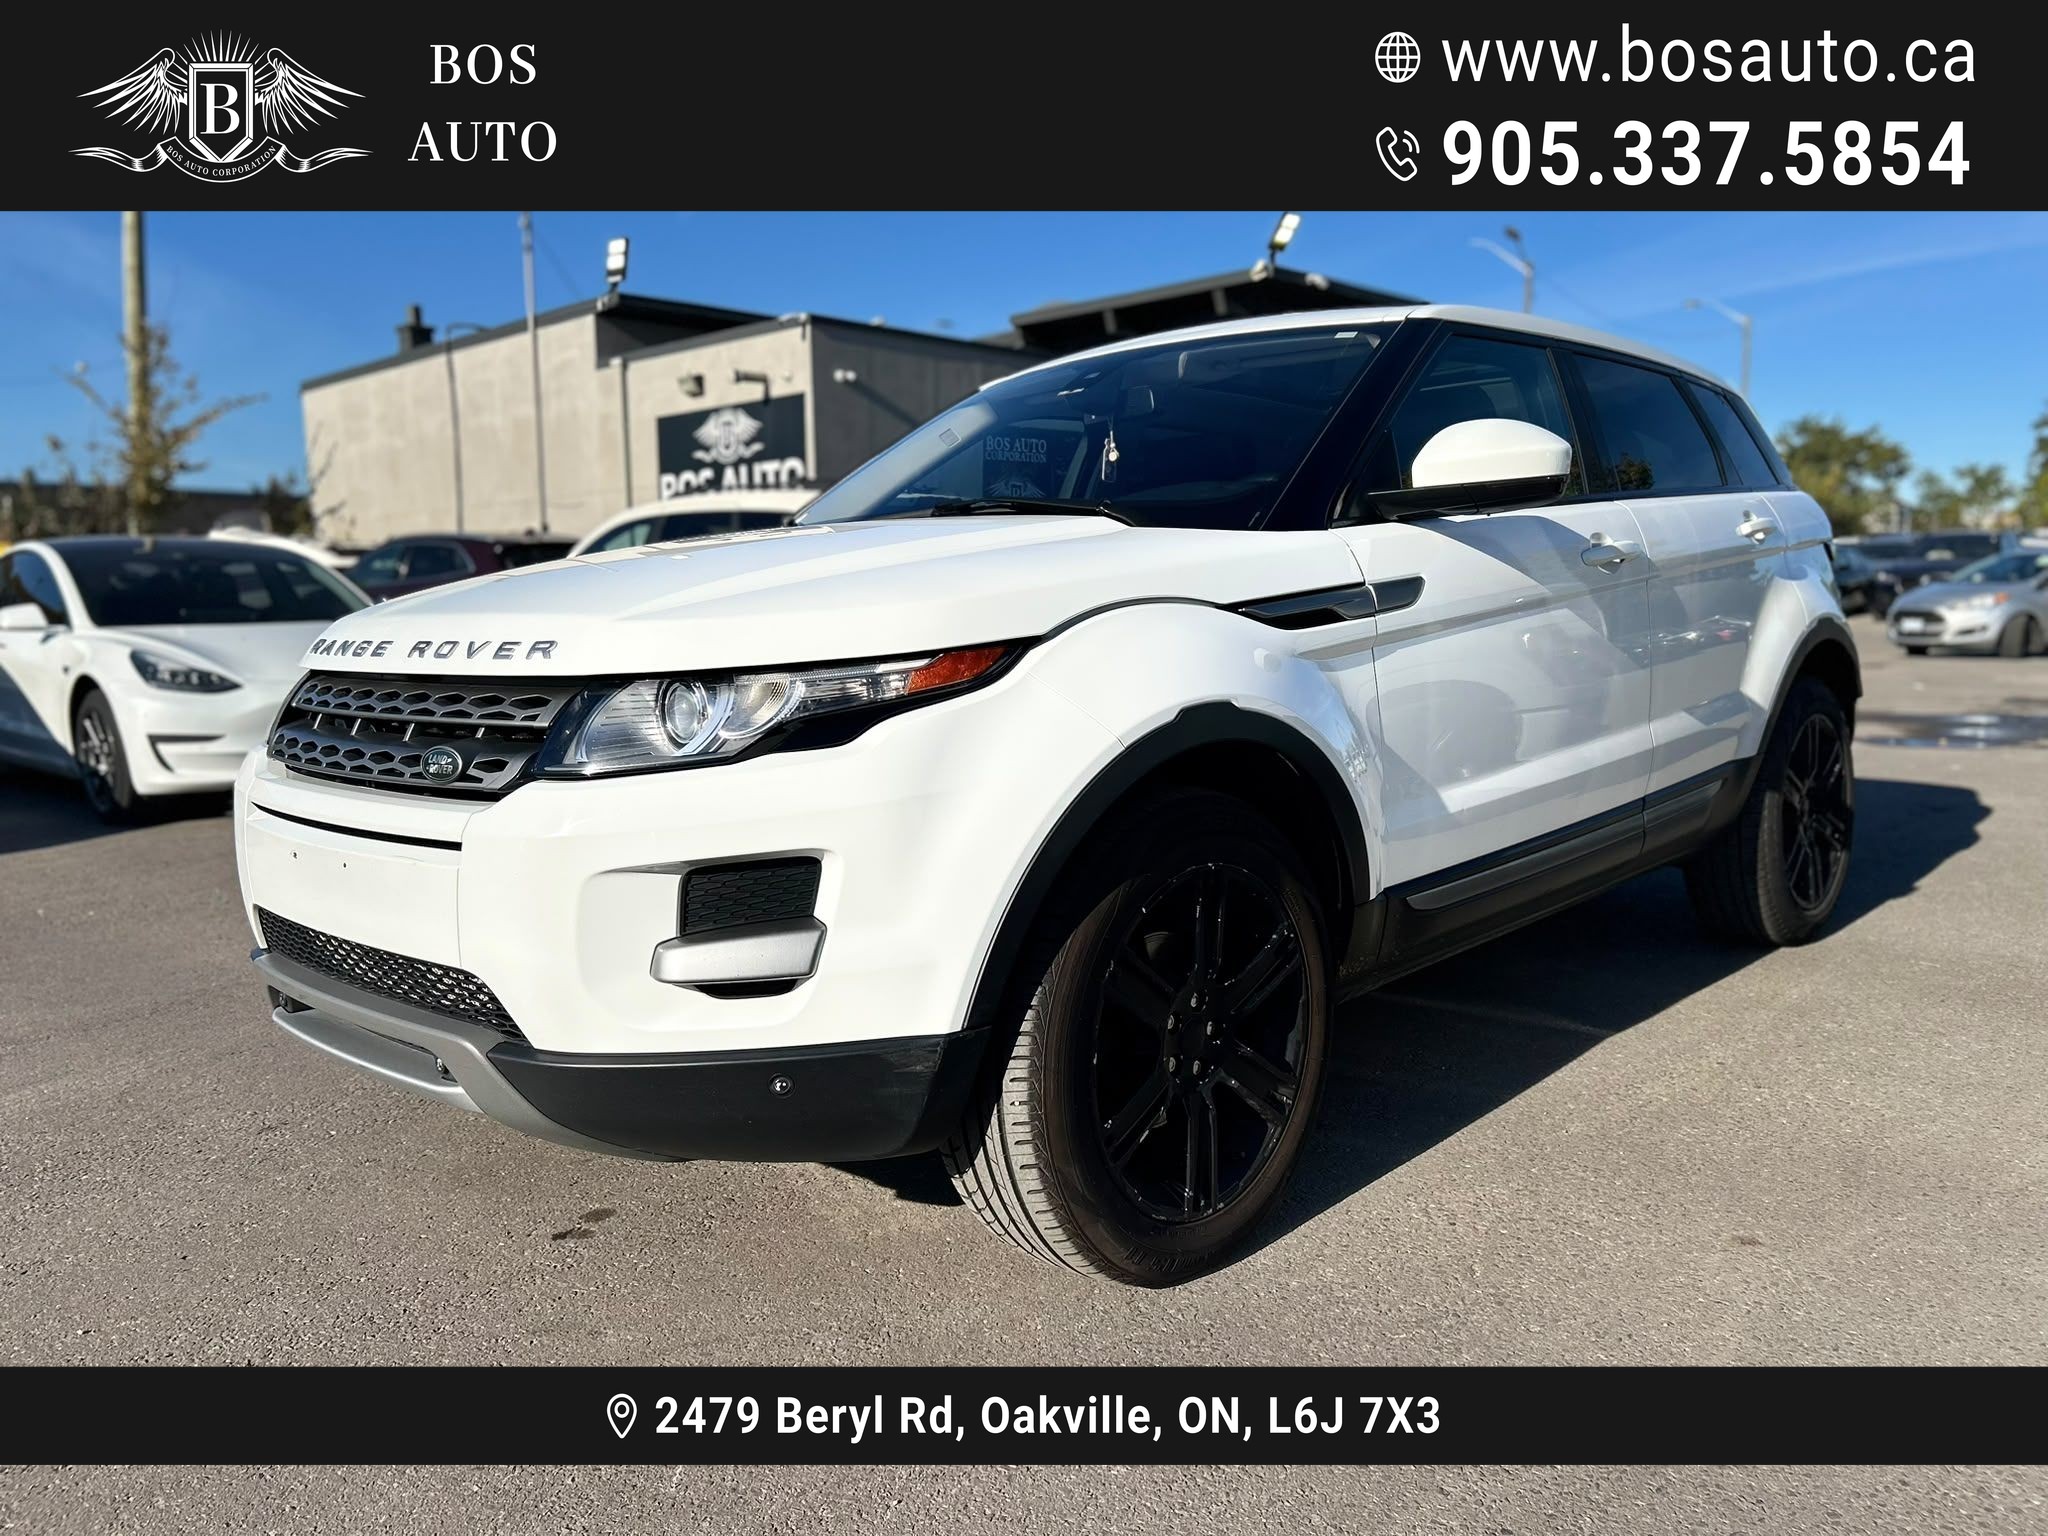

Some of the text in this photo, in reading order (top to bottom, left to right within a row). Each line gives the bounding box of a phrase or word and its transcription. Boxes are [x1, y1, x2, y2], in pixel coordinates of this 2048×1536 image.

[985, 435, 1047, 453] BOS AUTO
[985, 450, 1047, 463] CORPORATION
[309, 638, 559, 661] RANGE ROVER
[428, 754, 448, 765] LAND
[429, 763, 453, 774] ROVER
